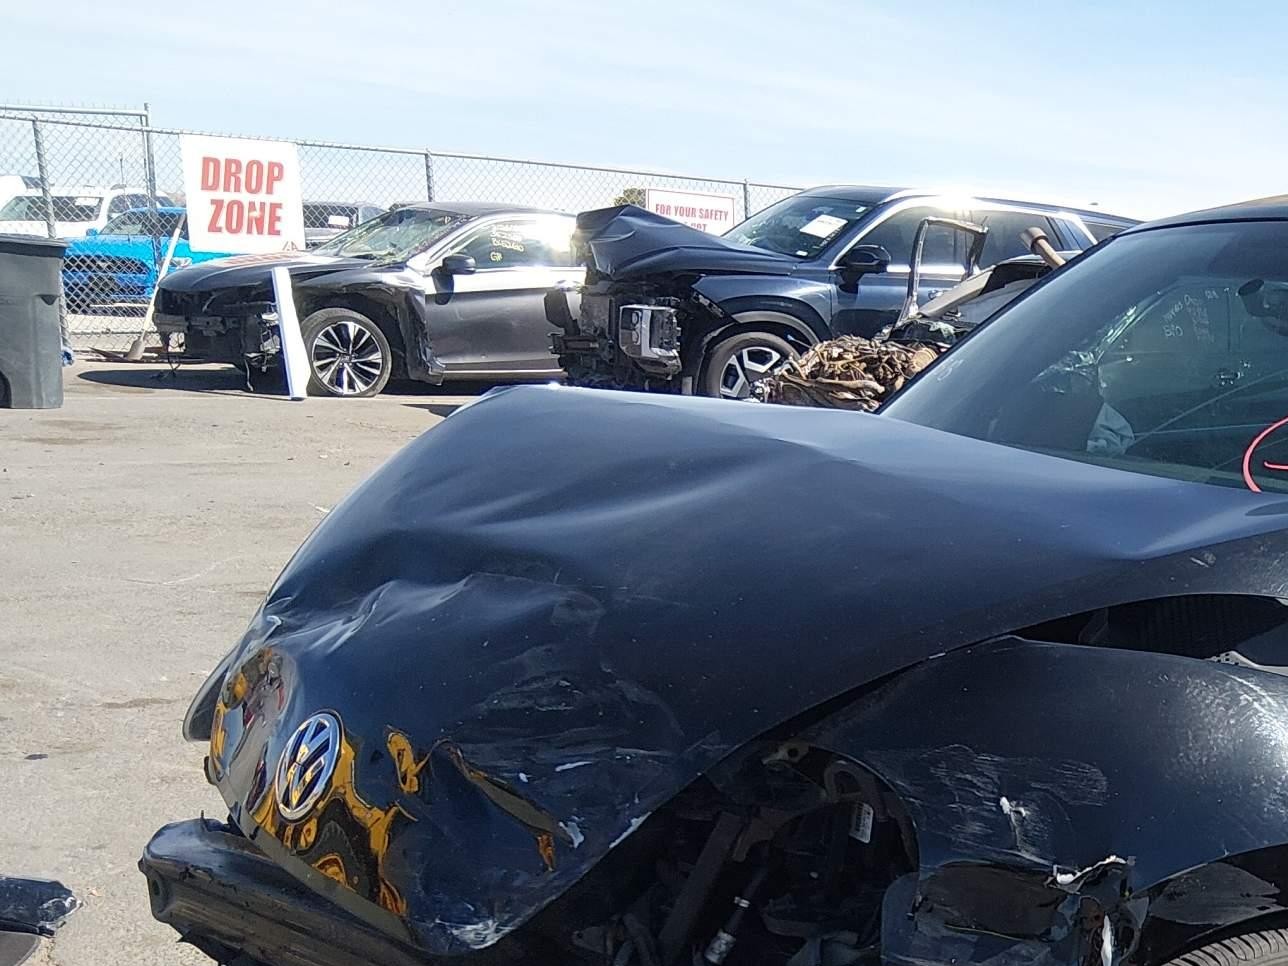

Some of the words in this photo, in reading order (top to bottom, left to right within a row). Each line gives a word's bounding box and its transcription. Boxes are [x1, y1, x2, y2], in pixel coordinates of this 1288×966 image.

[200, 156, 285, 196] DROP
[207, 198, 284, 237] ZONE
[655, 203, 672, 216] FOR
[674, 205, 698, 218] YOUR
[698, 207, 729, 221] SAFETY
